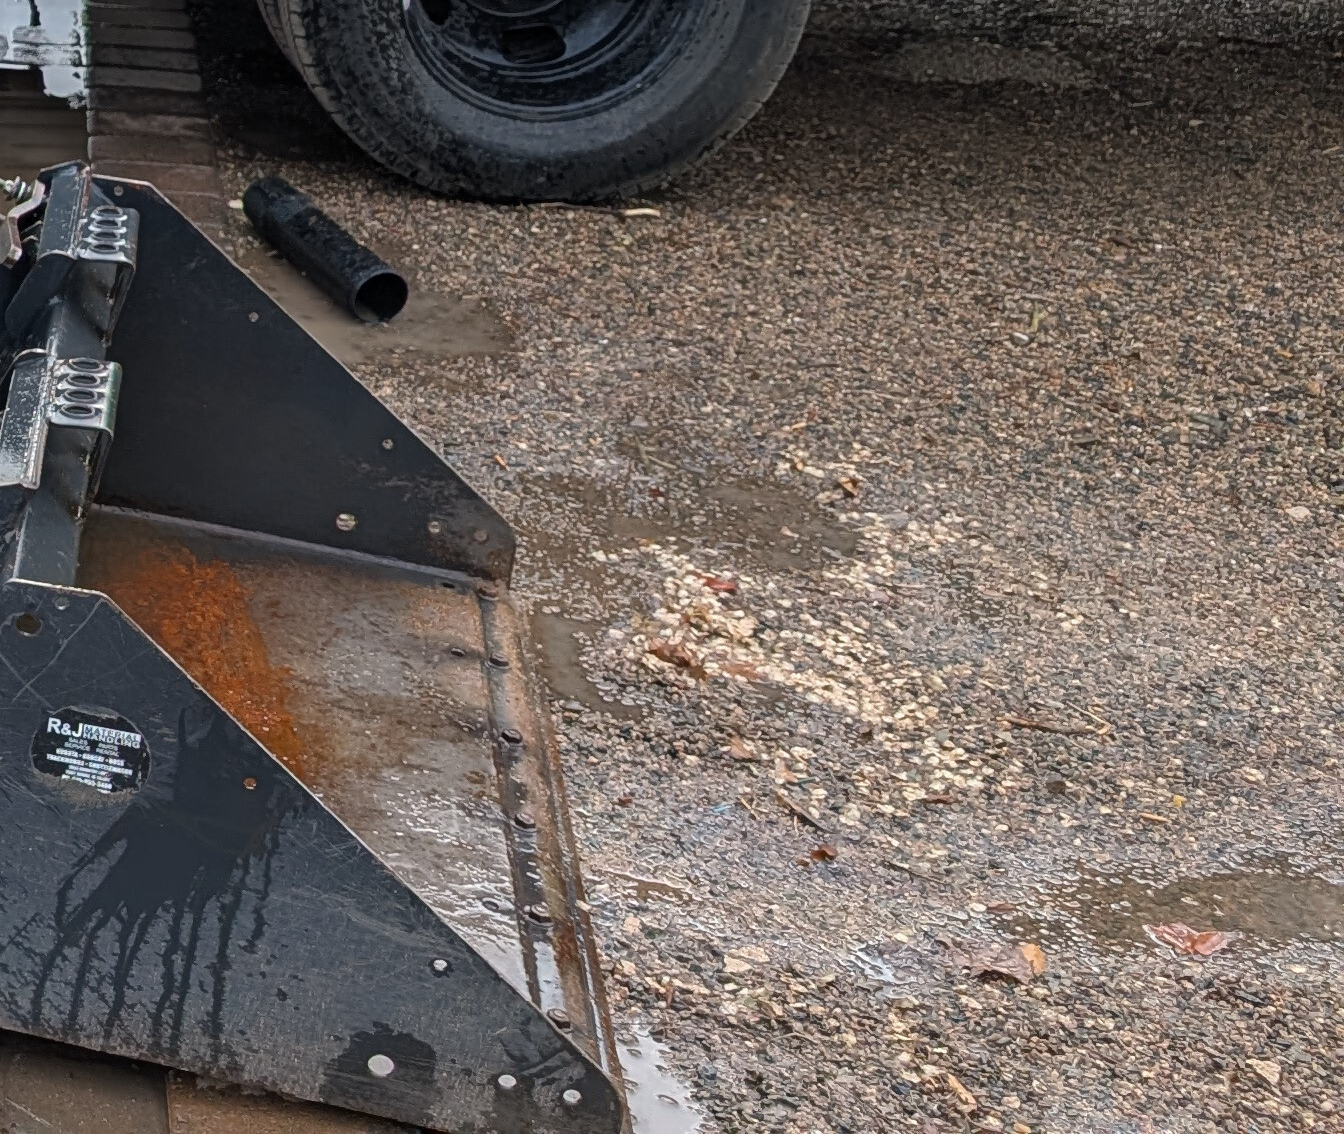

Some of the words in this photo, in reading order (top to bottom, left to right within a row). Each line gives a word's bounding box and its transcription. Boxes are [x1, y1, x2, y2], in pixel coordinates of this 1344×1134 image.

[47, 717, 83, 738] R&J
[84, 724, 141, 743] MATERIAL
[83, 733, 140, 749] HANDLING
